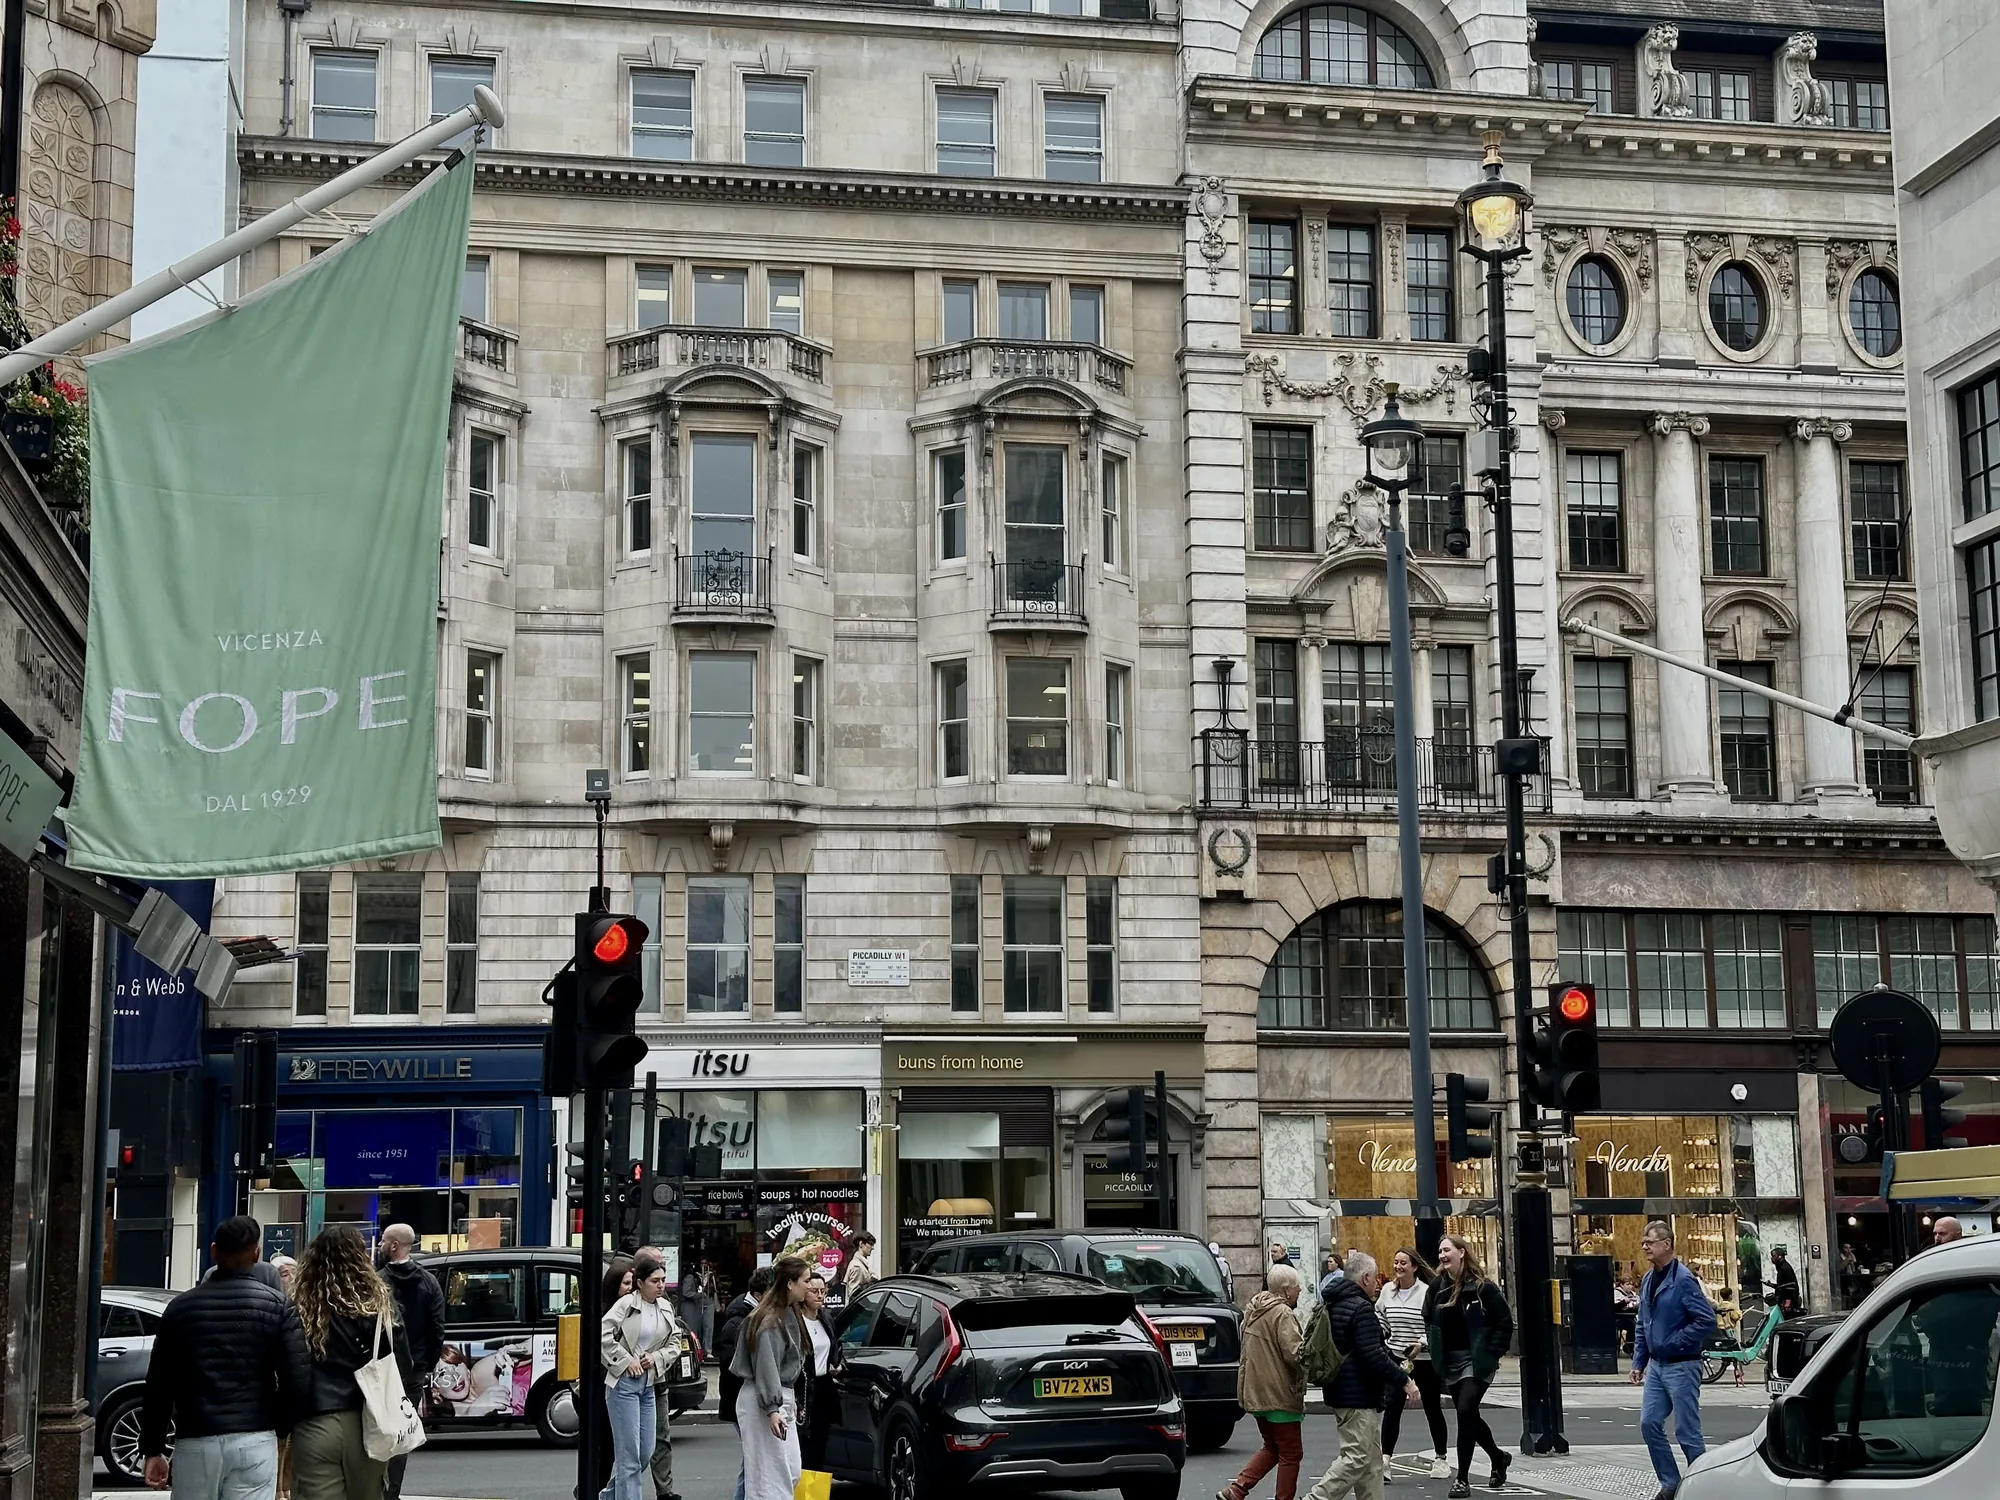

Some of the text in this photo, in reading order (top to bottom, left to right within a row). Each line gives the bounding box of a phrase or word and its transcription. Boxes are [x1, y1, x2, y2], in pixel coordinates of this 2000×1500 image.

[217, 629, 324, 652] VICENZA
[108, 670, 408, 754] FOPE
[0, 763, 30, 823] OPE
[206, 785, 312, 812] DAL 1929
[852, 951, 906, 960] PICCADILLY W1
[131, 978, 141, 996] &
[146, 976, 185, 996] Webb
[318, 1057, 473, 1080] FREYWILLE
[692, 1050, 750, 1076] itsu
[898, 1054, 1024, 1069] buns from home
[687, 1111, 753, 1147] itsu
[357, 1149, 408, 1159] since 1951
[722, 1149, 749, 1158] utiful
[1358, 1140, 1417, 1172] Venc
[1596, 1140, 1670, 1172] Venchi
[1121, 1172, 1137, 1182] 166
[708, 1191, 722, 1200] rice
[722, 1189, 744, 1200] bowls
[760, 1188, 859, 1202] soups hot noodles
[1104, 1183, 1153, 1192] PICCADILLY
[765, 1211, 804, 1239] health
[805, 1212, 854, 1238] yourself
[903, 1217, 994, 1226] We started from home
[916, 1227, 982, 1237] We made it here
[1180, 1327, 1199, 1338] YSR
[541, 1348, 556, 1356] AN
[1063, 1361, 1088, 1370] KIA
[423, 1373, 462, 1388] KSY
[1043, 1377, 1110, 1394] BV72 XWS
